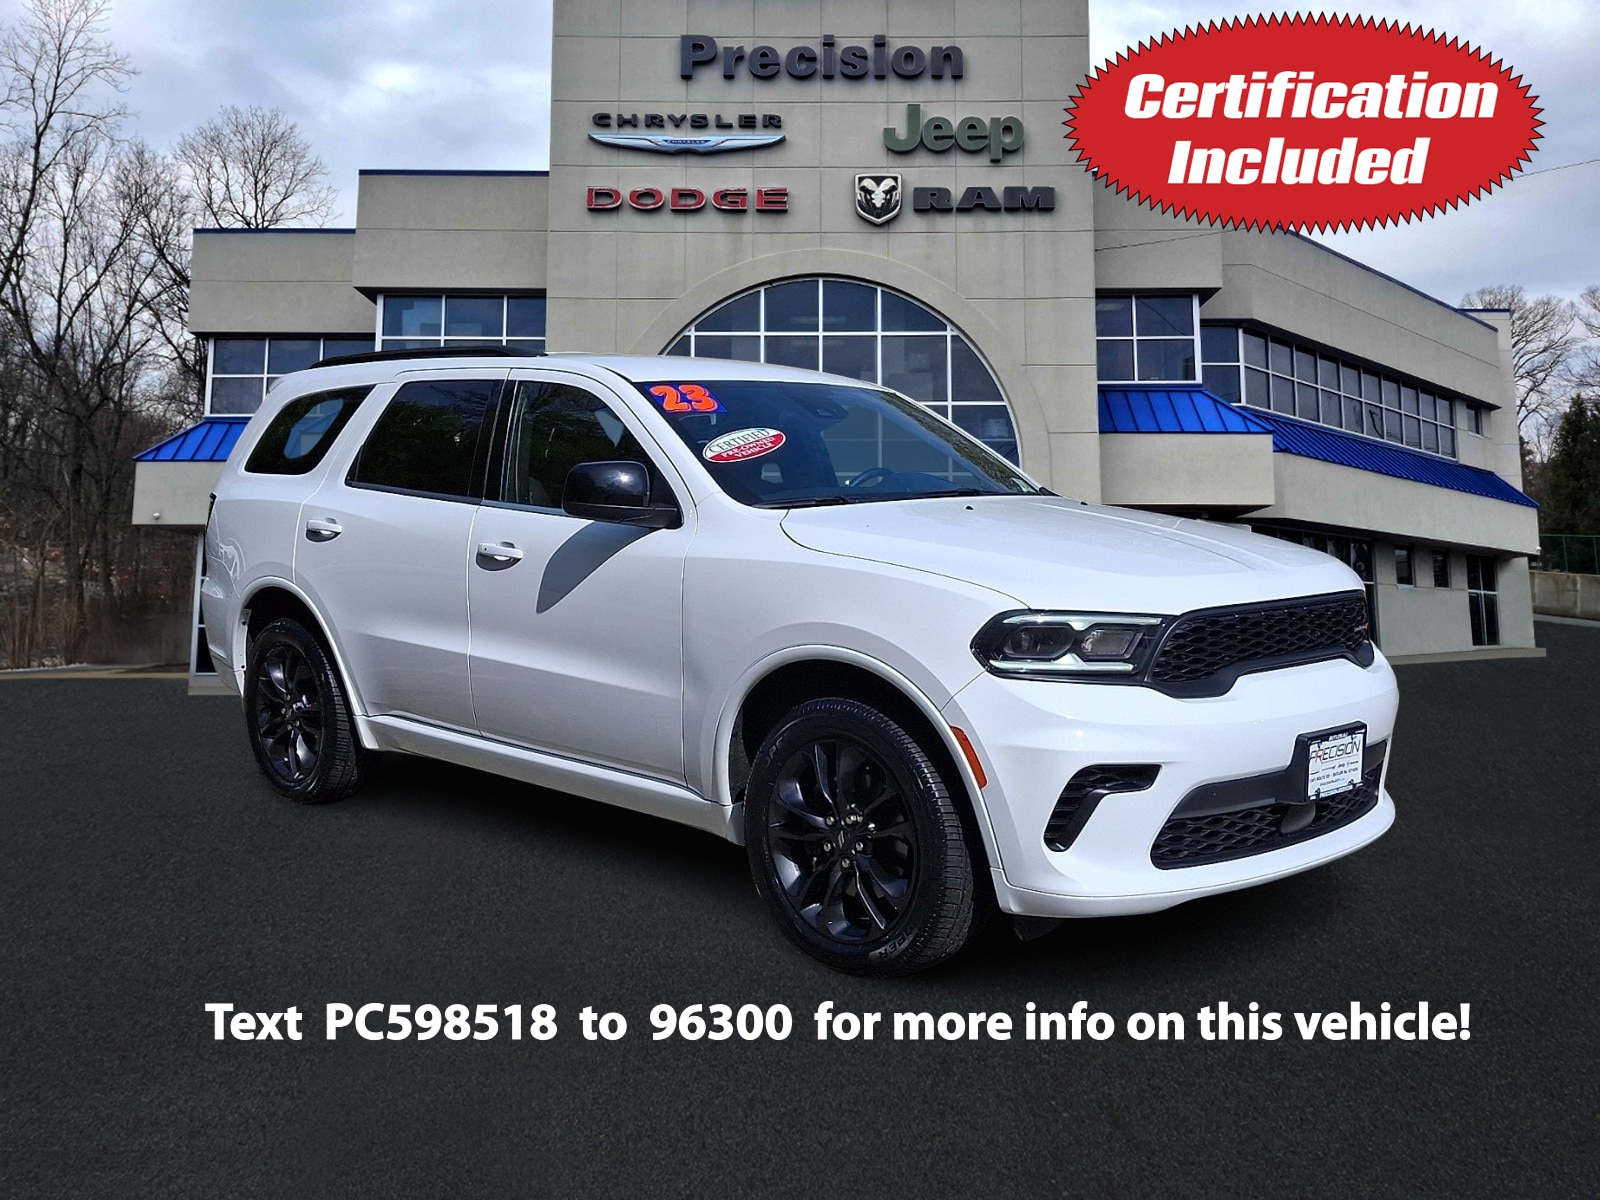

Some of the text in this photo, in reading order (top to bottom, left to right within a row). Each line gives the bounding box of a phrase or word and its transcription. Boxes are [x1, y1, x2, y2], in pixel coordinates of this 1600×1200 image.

[681, 34, 964, 79] Precision
[592, 113, 782, 129] CHRYSLER
[883, 104, 1025, 163] Jeep
[586, 187, 789, 211] DODGE
[913, 186, 1055, 212] RAM
[650, 384, 719, 412] 23
[709, 429, 770, 453] CERTIFIED
[1310, 740, 1360, 763] PRECISION
